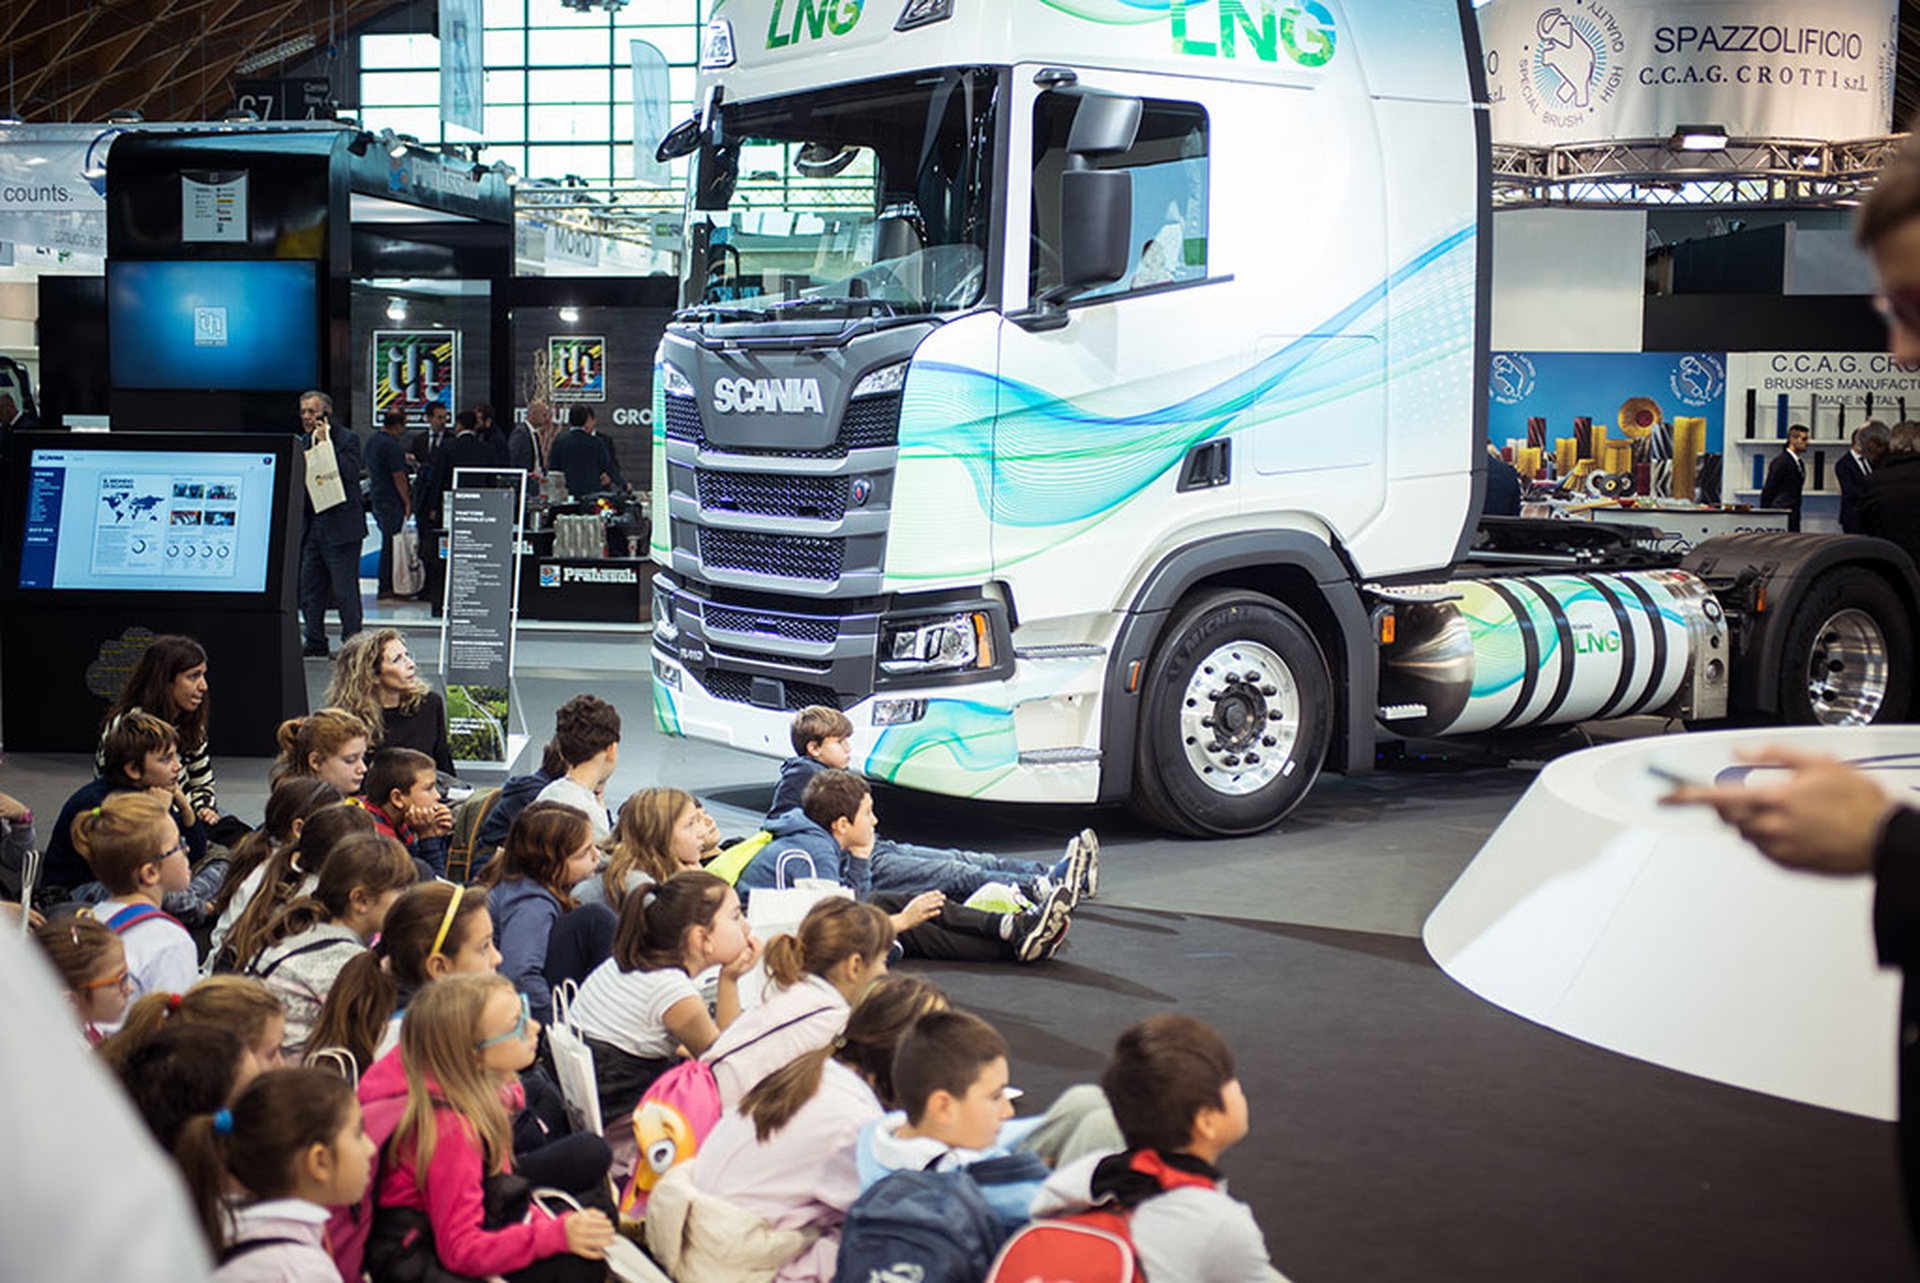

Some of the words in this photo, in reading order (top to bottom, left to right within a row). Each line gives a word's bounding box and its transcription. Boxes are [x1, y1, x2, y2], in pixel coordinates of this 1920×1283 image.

[765, 0, 865, 50] LNG
[1170, 0, 1336, 67] LNG
[1587, 1, 1625, 53] QUALITY
[1654, 25, 1862, 60] SPAZZOLIFICIO
[1600, 65, 1624, 103] HIGH
[1638, 65, 1728, 86] C.C.A.G.
[1518, 59, 1539, 116] SPECIAL
[1542, 111, 1584, 128] BRUSH
[3, 184, 74, 202] counts.
[1772, 355, 1861, 373] C.C.A.G.
[713, 377, 824, 414] SCANIA
[1764, 378, 1834, 390] BRUSHES
[563, 567, 638, 584] Pratissoli
[1573, 630, 1620, 653] LNG
